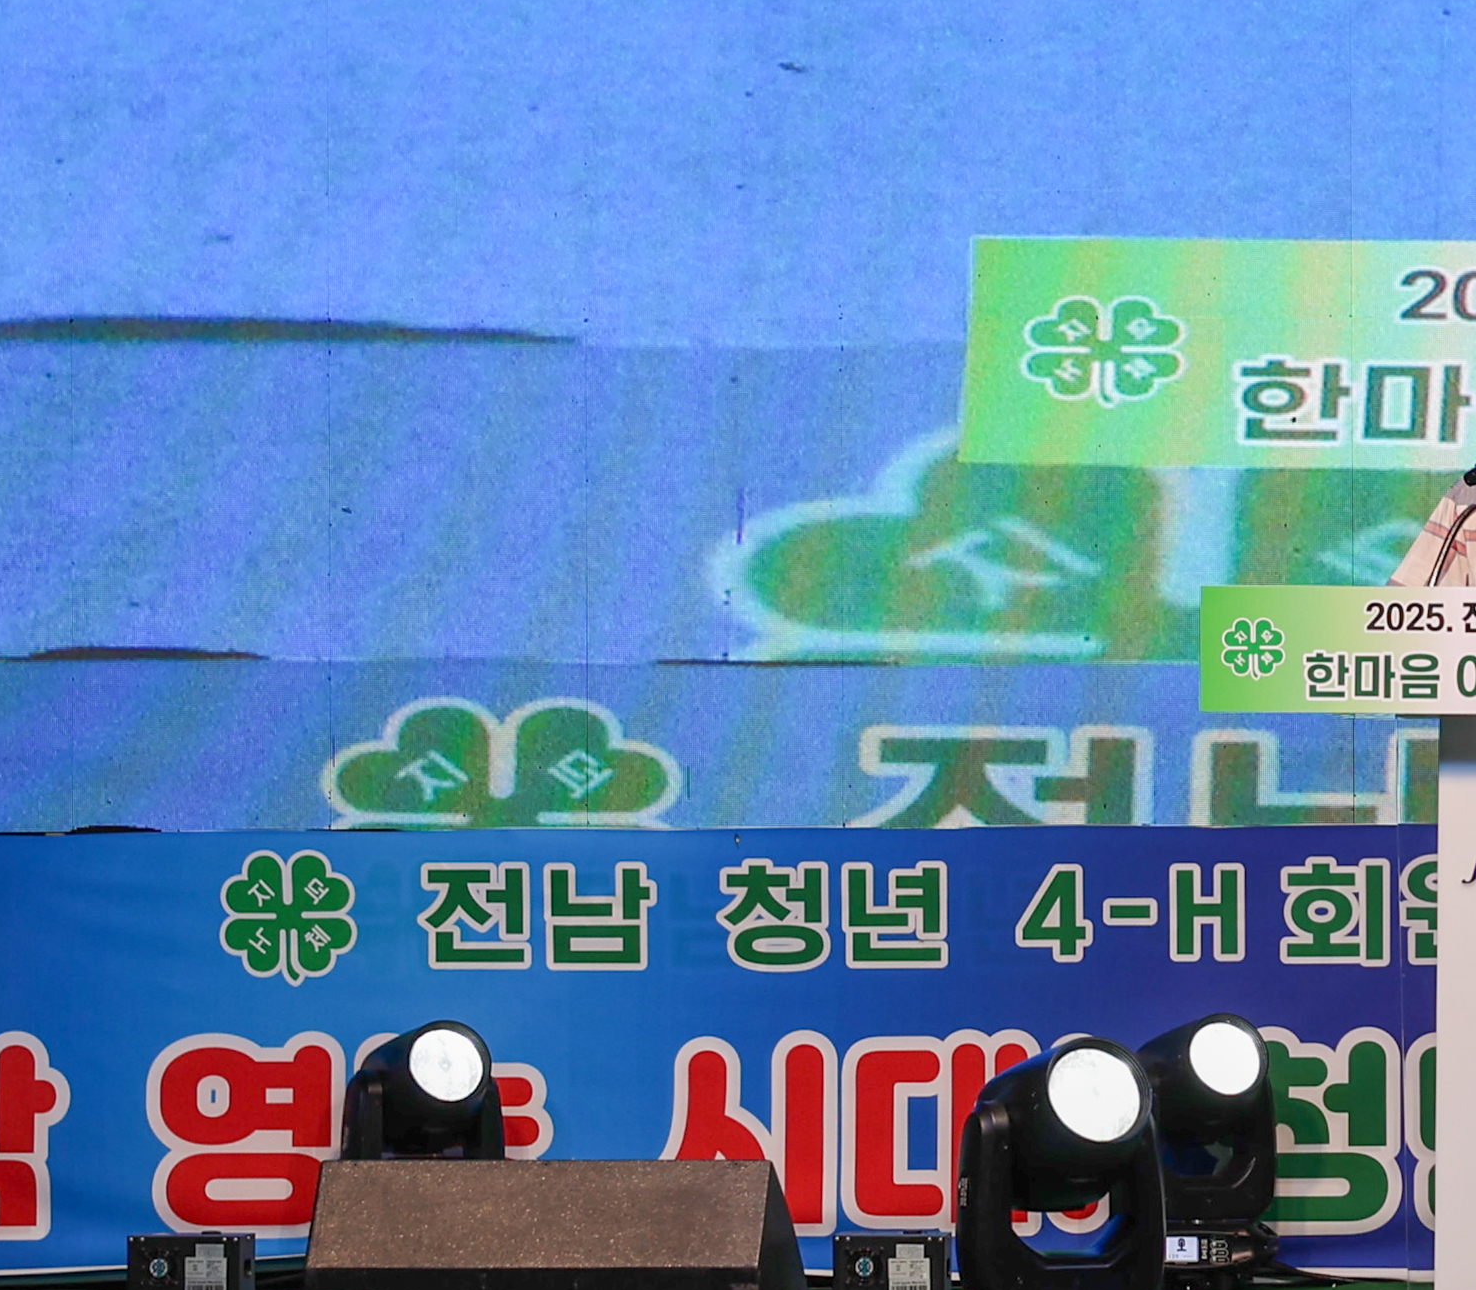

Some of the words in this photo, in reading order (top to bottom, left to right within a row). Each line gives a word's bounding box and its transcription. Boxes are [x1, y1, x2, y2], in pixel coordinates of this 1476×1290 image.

[1364, 601, 1454, 634] 2025.
[1304, 651, 1442, 701] 한마음
[426, 865, 651, 967] 전남
[725, 862, 944, 967] 청년
[1021, 867, 1240, 958] 4-H
